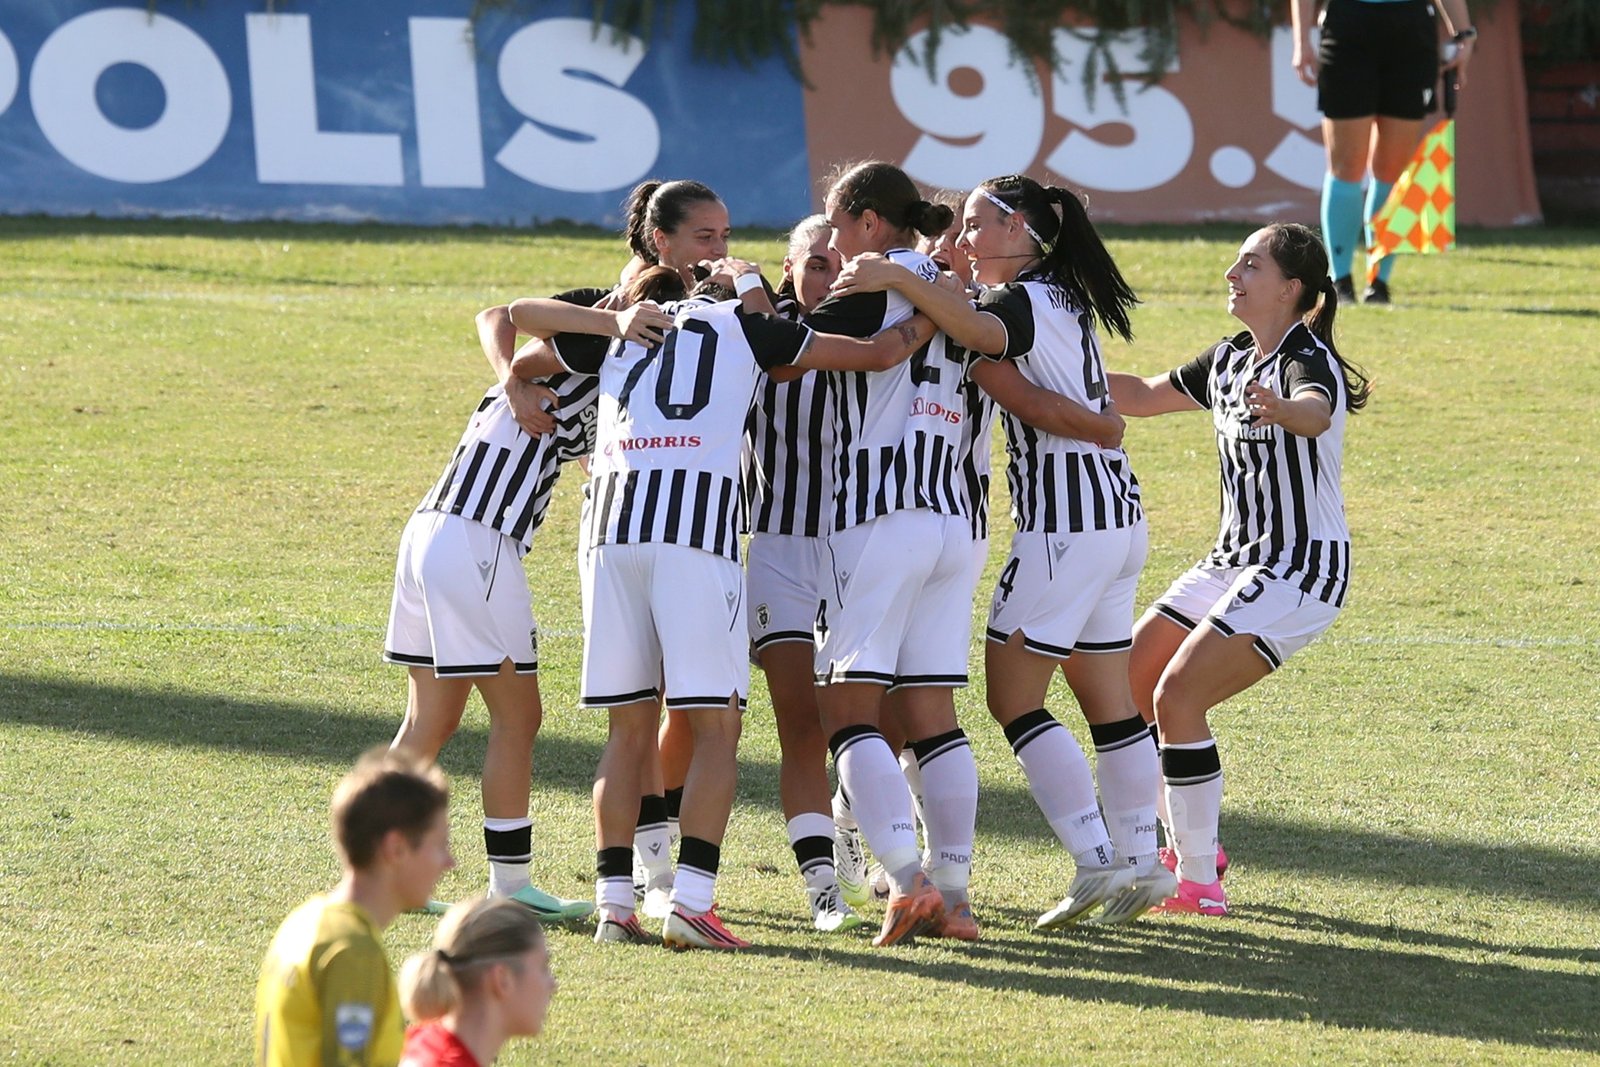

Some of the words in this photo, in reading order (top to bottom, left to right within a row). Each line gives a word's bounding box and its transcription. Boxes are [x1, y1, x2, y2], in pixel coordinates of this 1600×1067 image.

[0, 8, 660, 192] OLIS
[614, 318, 719, 421] 70
[619, 436, 701, 451] MORRIS
[999, 556, 1020, 602] 4
[1080, 809, 1100, 824] PAO
[1135, 824, 1157, 834] PAO
